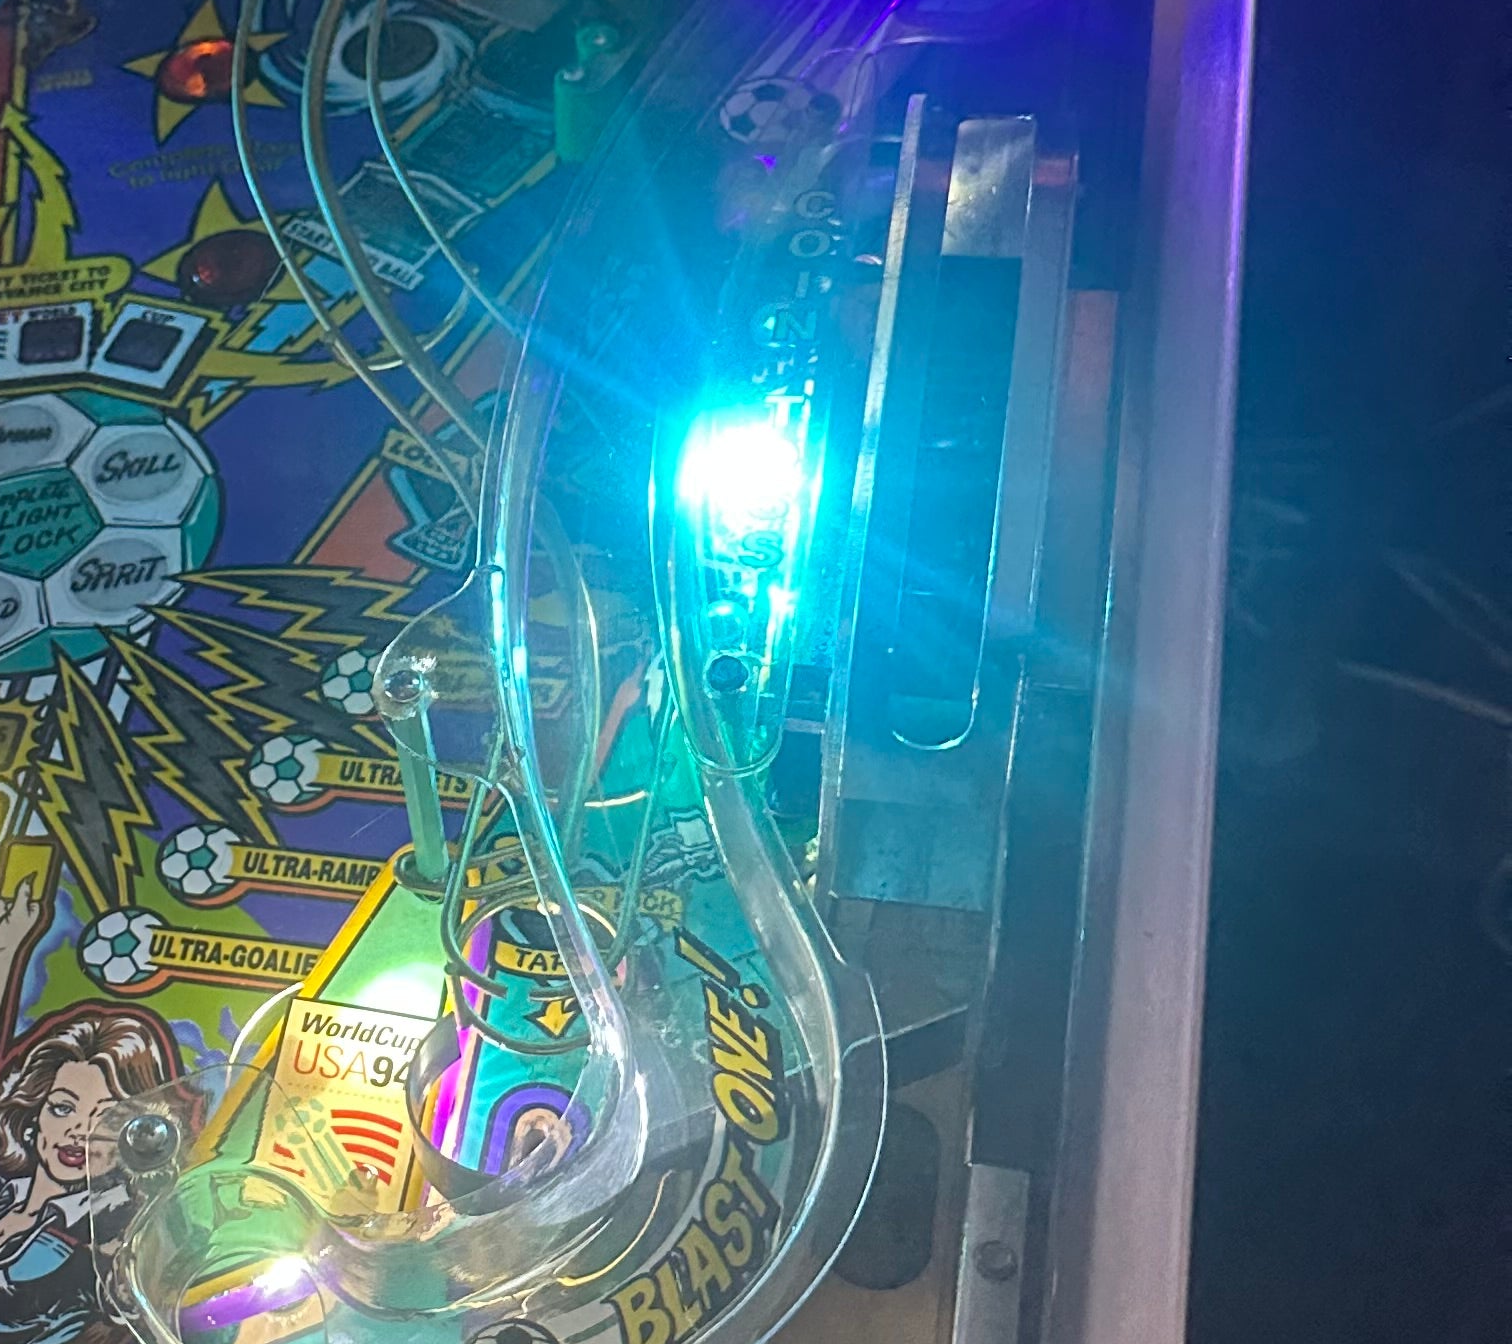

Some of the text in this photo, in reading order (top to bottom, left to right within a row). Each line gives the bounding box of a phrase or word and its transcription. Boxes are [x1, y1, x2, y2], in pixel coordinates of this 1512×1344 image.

[21, 268, 80, 286] TICKET
[87, 265, 110, 278] TO
[69, 278, 111, 293] CITY
[95, 450, 182, 486] SKILL
[301, 1012, 423, 1056] WorldCup
